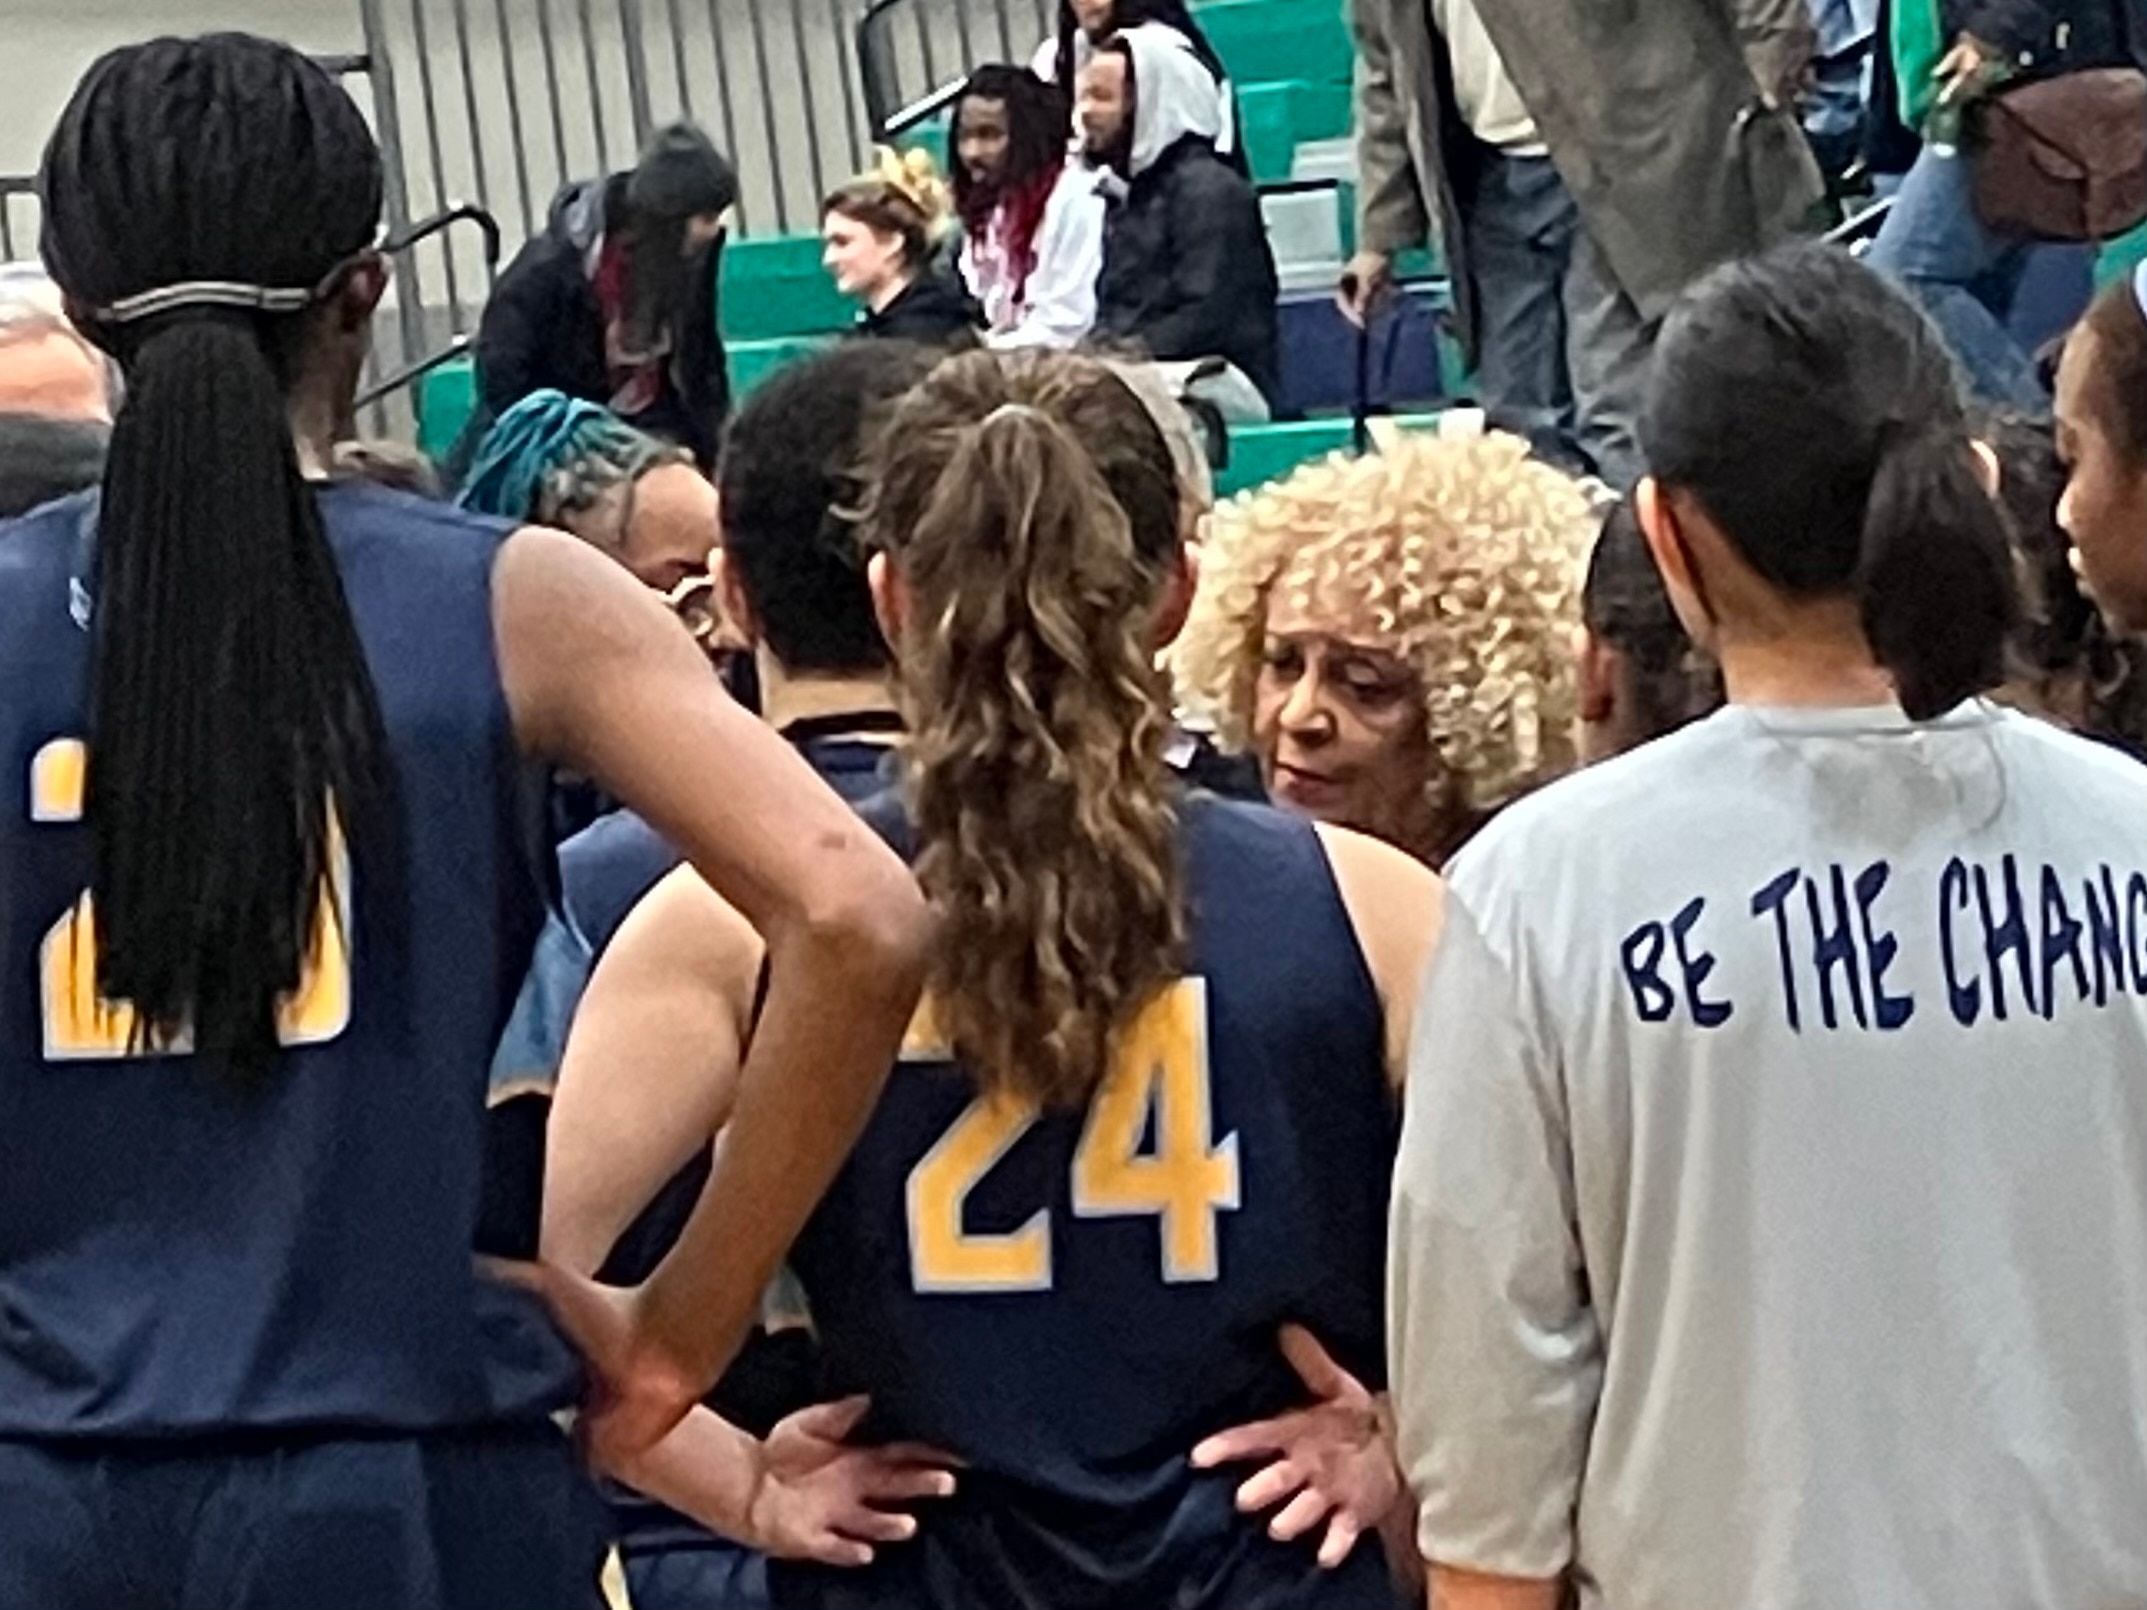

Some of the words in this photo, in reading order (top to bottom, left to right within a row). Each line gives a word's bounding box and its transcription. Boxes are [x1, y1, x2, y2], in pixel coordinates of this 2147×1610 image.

[1620, 897, 1734, 1029] BE
[1751, 860, 1915, 1034] THE
[898, 976, 1241, 1292] 24
